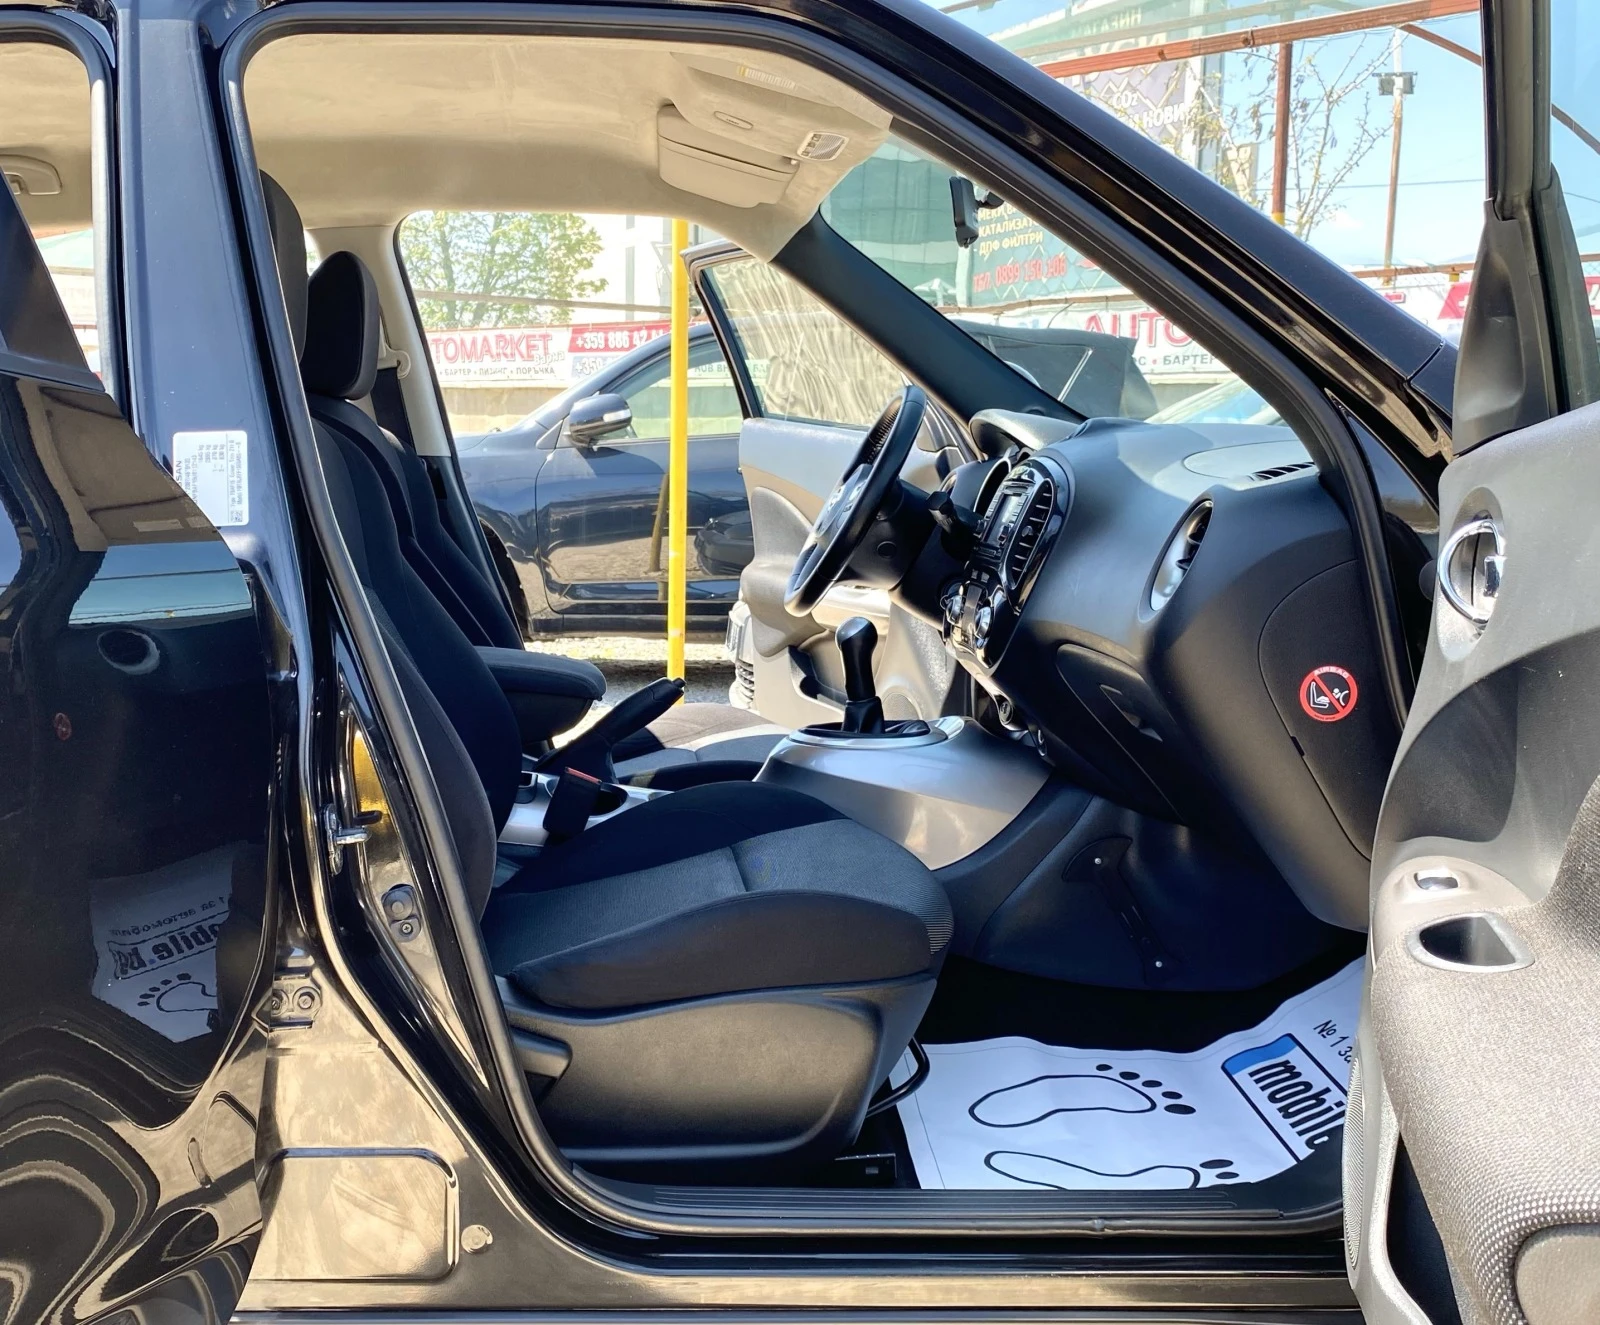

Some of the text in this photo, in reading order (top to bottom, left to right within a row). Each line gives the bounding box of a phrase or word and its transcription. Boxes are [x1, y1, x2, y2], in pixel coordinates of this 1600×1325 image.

[1002, 231, 1043, 249] ФИЛТРИ
[576, 331, 605, 349] +359
[516, 366, 555, 375] ПОРЪЧКА
[1313, 666, 1350, 679] AIRBAG
